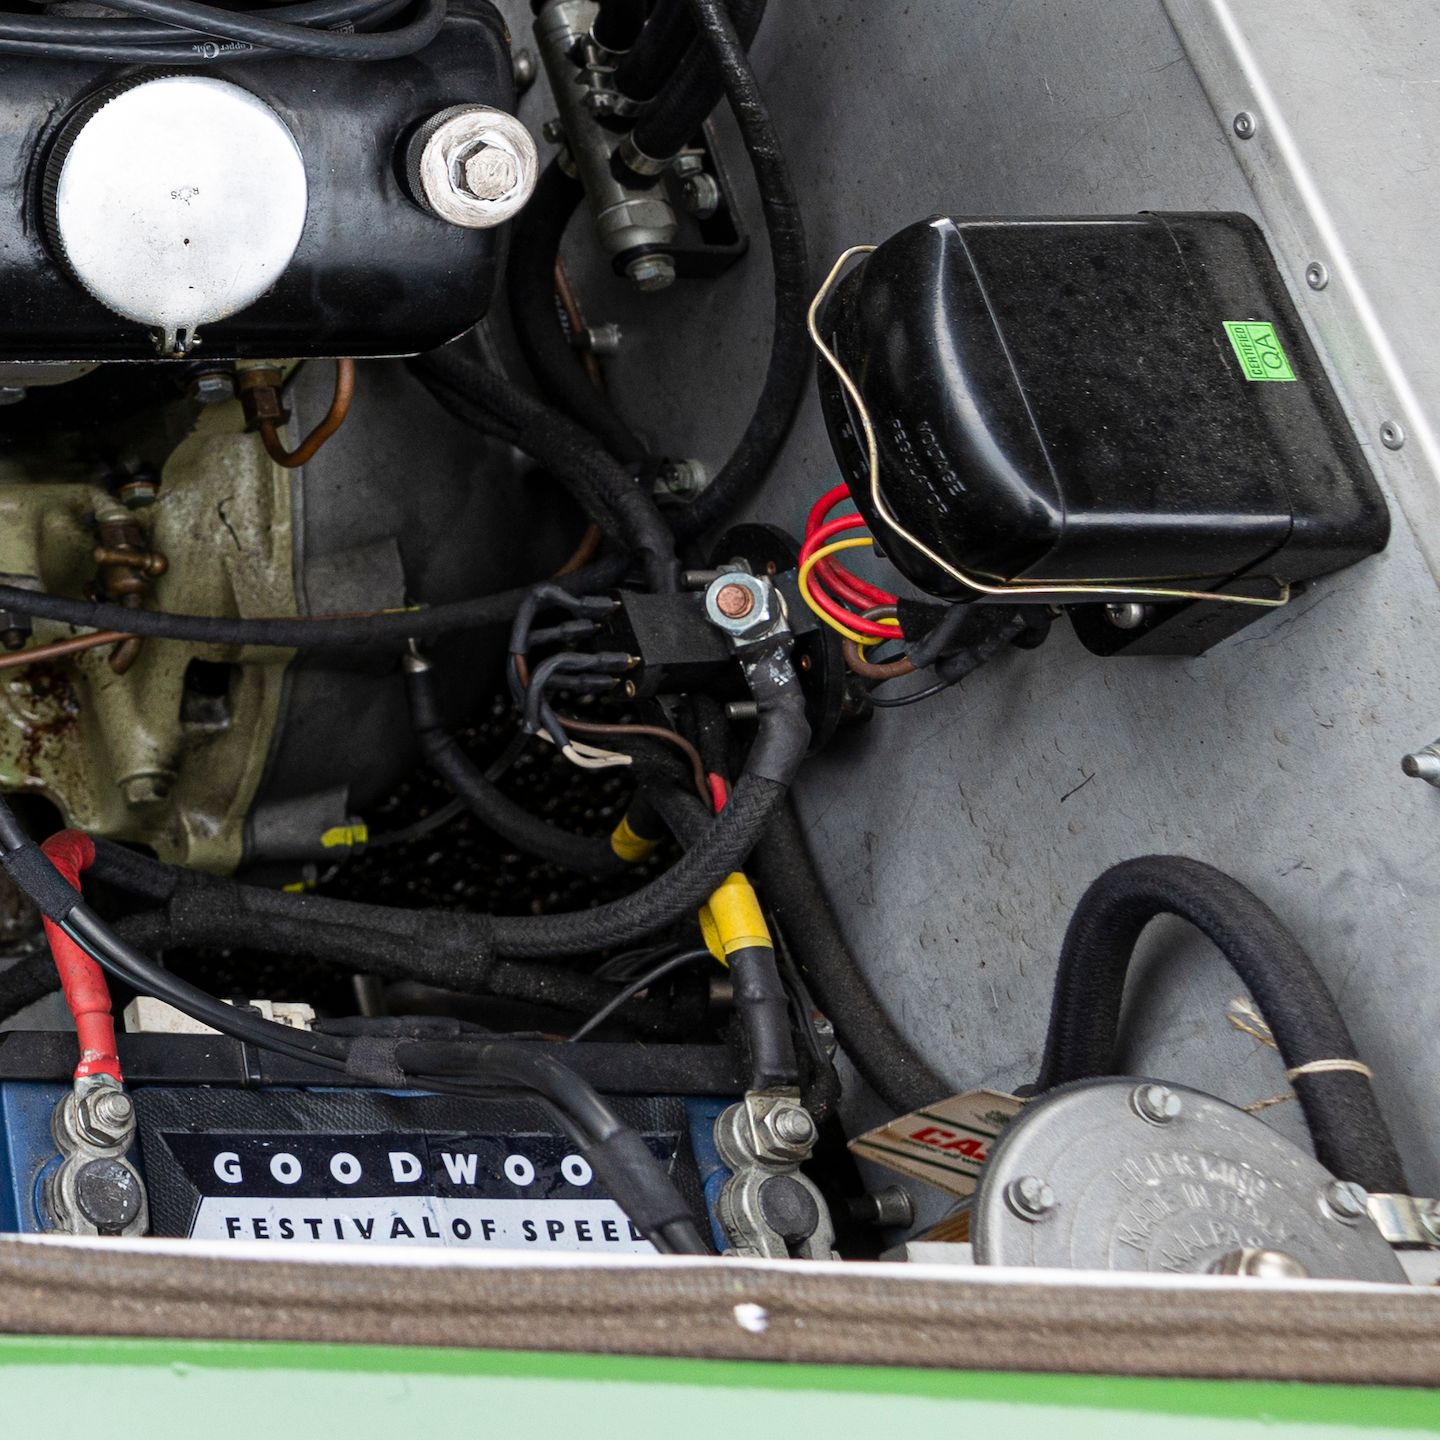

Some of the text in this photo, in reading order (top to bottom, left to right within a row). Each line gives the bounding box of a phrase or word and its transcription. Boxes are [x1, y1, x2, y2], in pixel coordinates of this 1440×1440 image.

[1234, 327, 1263, 375] CERTIFIED
[1255, 333, 1283, 369] QA
[910, 1126, 988, 1162] CA
[214, 1151, 594, 1186] GOODWOO
[226, 1216, 441, 1241] FESTIVAL
[452, 1217, 497, 1241] OF
